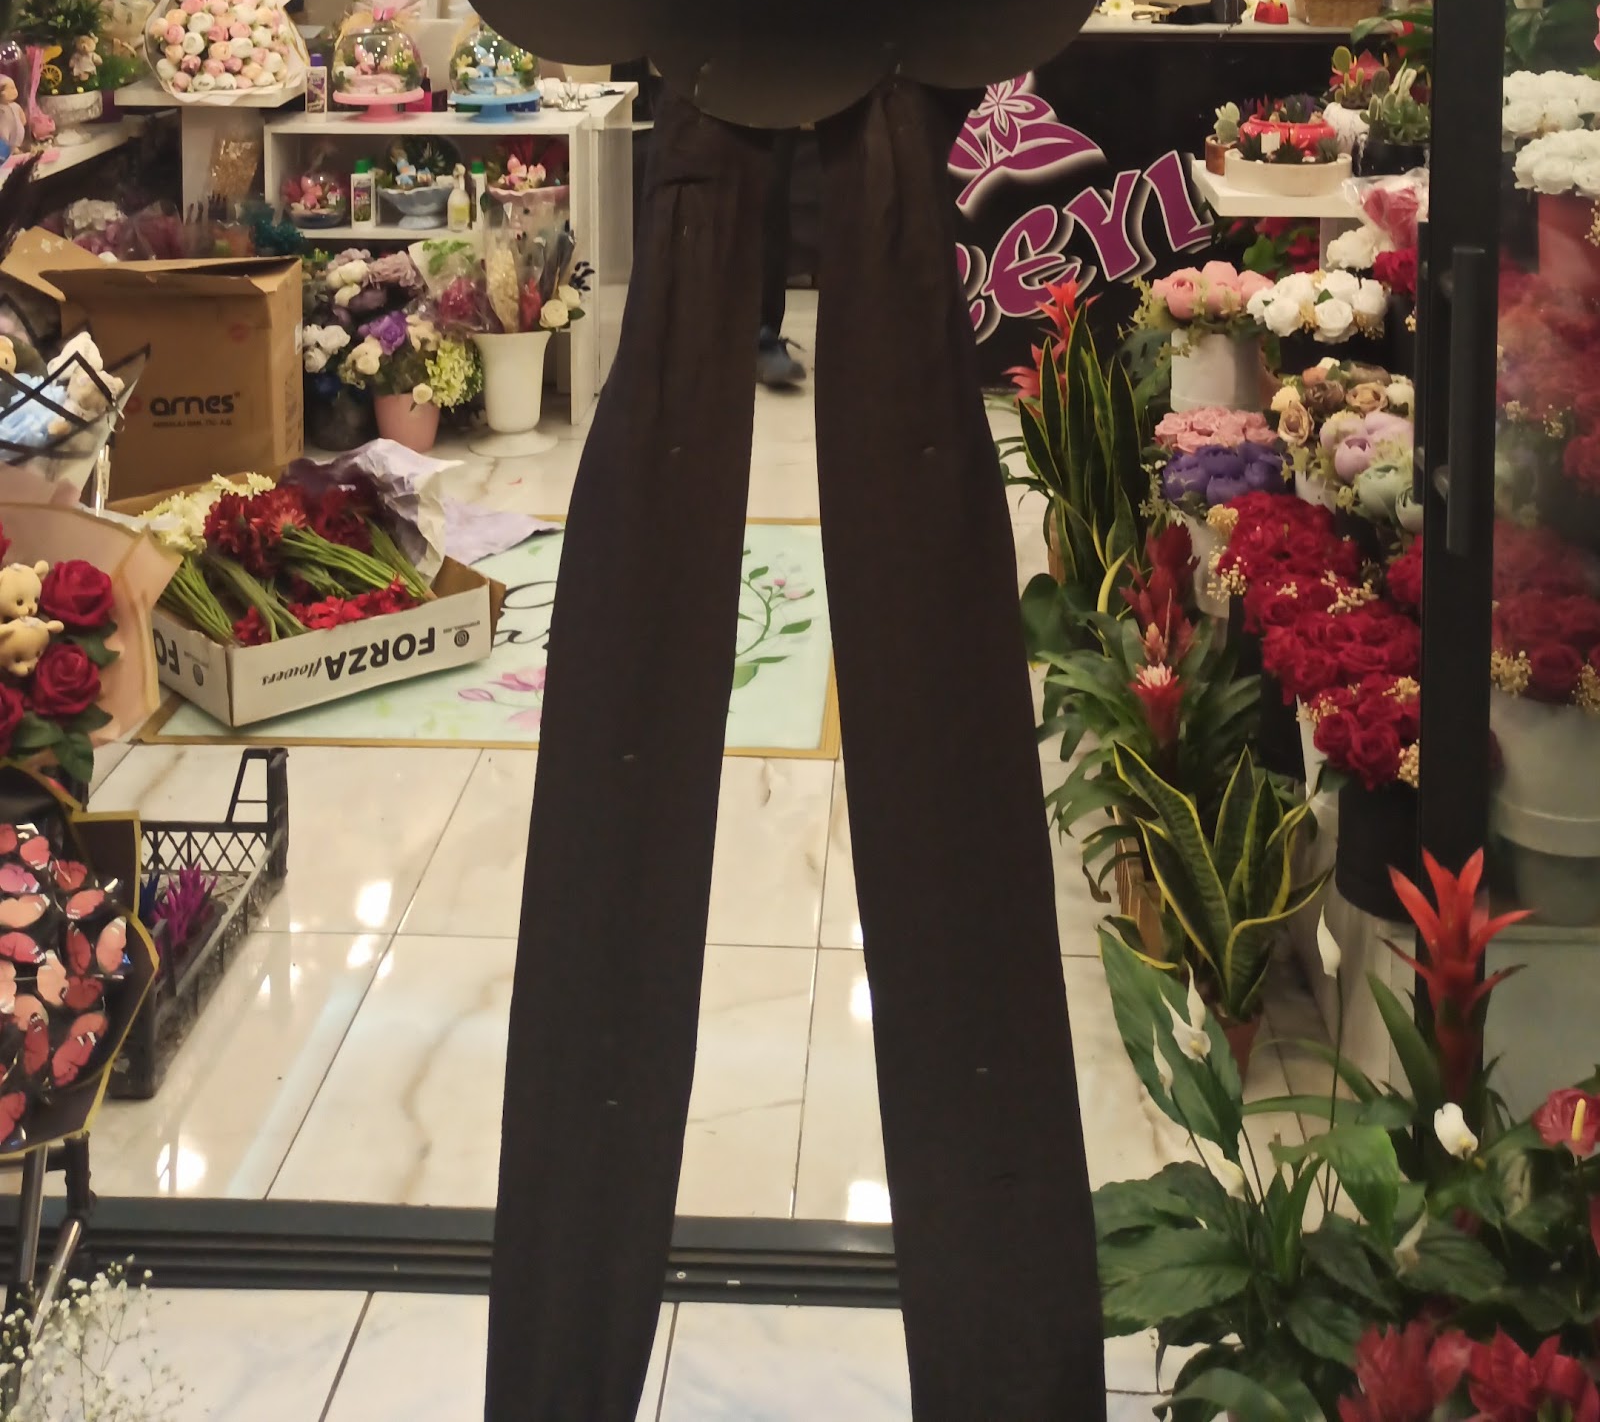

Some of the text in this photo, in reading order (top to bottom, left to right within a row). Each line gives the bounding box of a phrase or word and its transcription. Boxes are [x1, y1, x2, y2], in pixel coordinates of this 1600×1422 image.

[150, 394, 234, 416] arnes
[325, 626, 436, 682] FORZA
[261, 656, 323, 687] flowers
